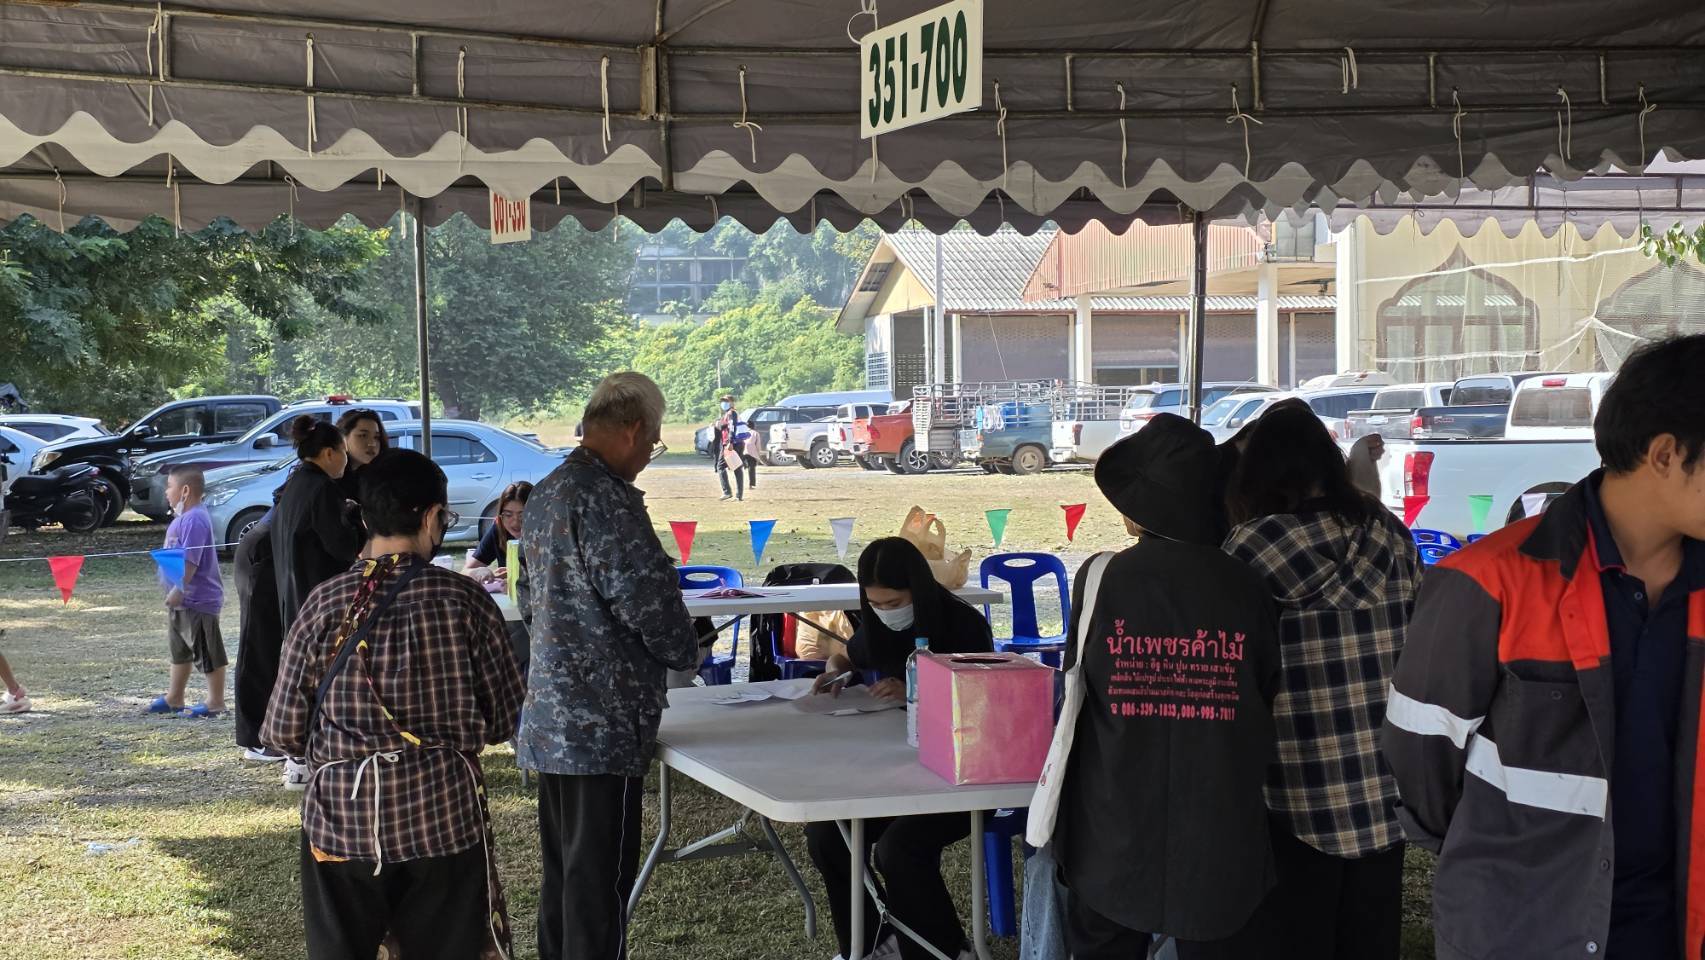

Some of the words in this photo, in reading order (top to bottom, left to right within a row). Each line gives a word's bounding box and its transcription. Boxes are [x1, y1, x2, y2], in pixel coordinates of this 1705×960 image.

[869, 10, 968, 128] 351-700
[1106, 618, 1245, 661] น้ำเพชรค้าไม้
